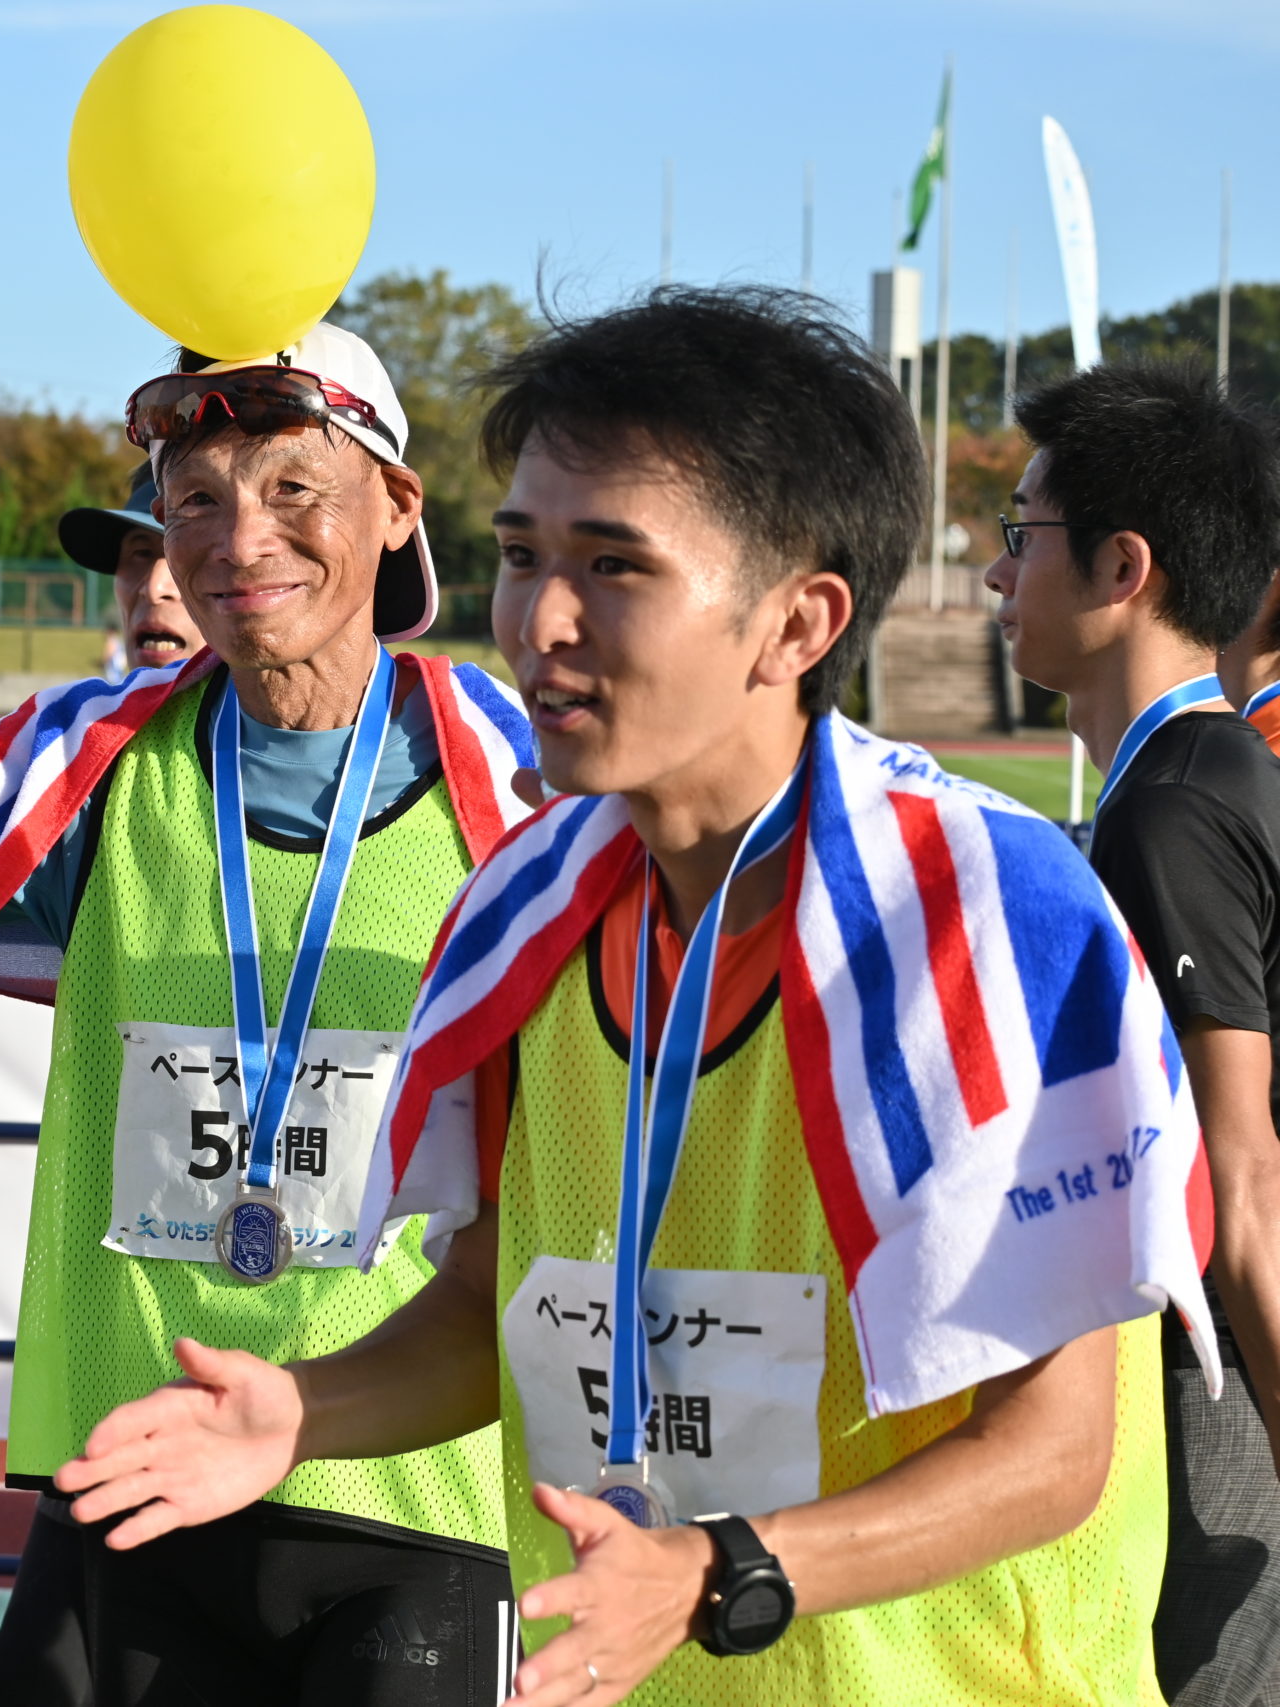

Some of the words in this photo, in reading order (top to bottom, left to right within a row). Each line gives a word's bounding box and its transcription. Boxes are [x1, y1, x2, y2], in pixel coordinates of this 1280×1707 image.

[150, 1052, 374, 1091] ペースナー
[240, 1205, 270, 1219] HITACHI
[1005, 1185, 1055, 1222] The
[1056, 1164, 1098, 1204] 1st
[536, 1293, 762, 1348] ペースンナー
